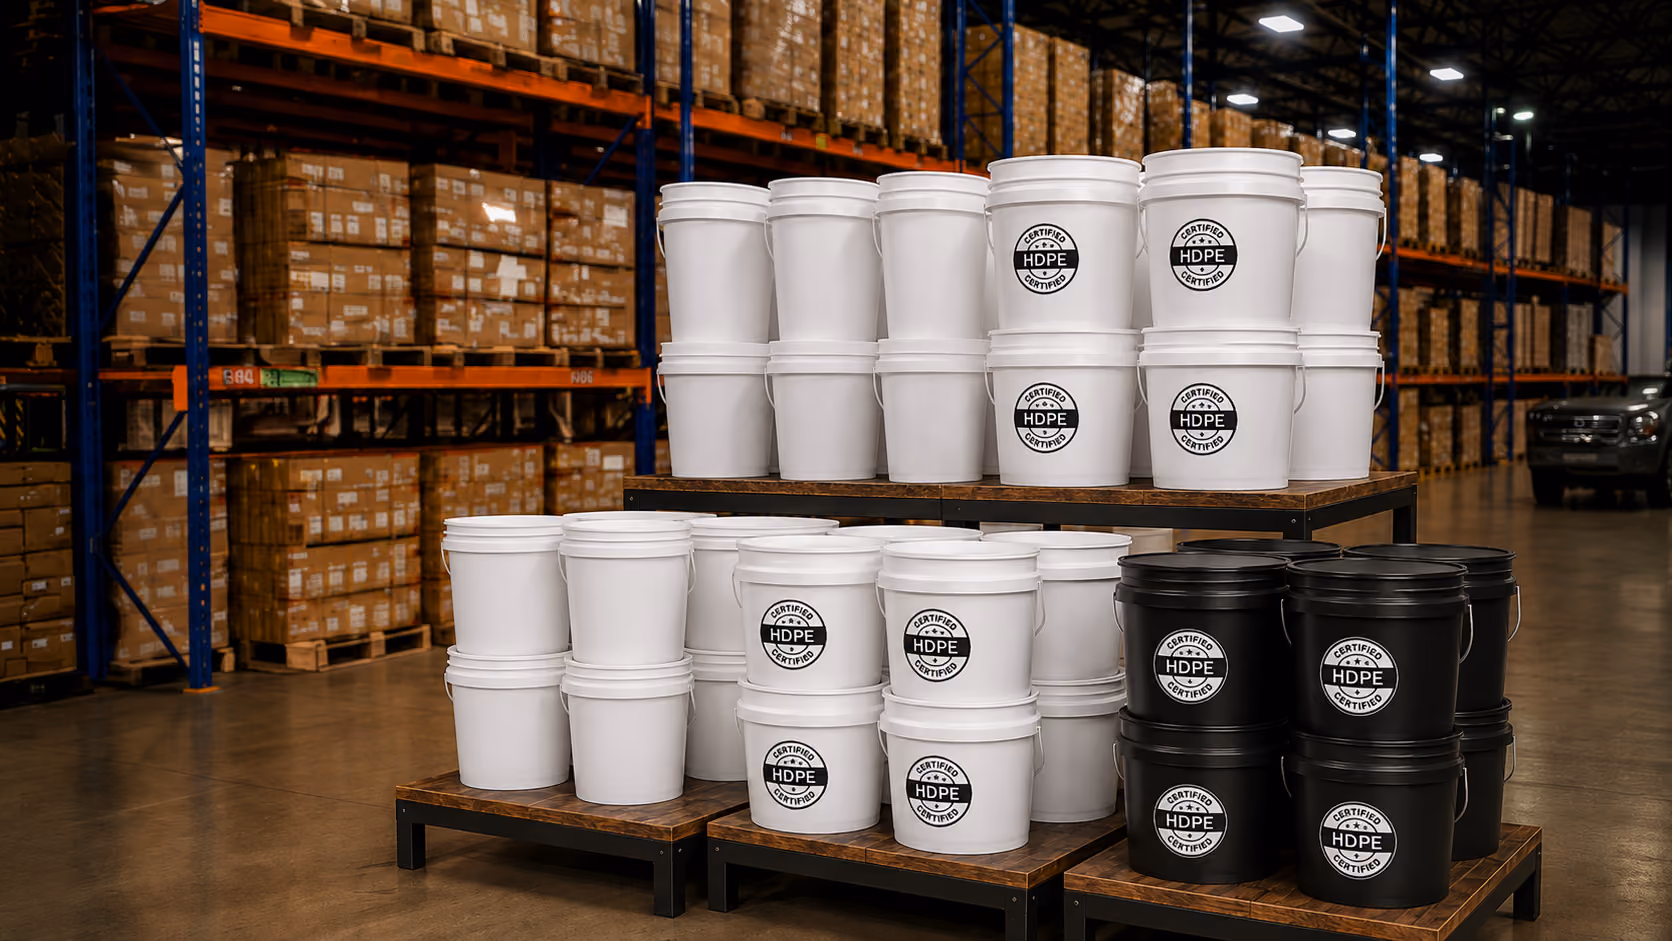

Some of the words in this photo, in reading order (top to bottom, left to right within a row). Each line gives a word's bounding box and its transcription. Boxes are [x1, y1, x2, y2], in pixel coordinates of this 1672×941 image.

[1024, 228, 1067, 244] CERTIFIED
[1180, 224, 1224, 239] CERTIFIED
[1024, 253, 1067, 267] HDPE
[1180, 249, 1225, 263] HDPE
[1024, 274, 1066, 290] CERTIFIED
[1180, 270, 1225, 286] CERTIFIED
[1024, 388, 1067, 403] CERTIFIED
[1180, 388, 1225, 403] CERTIFIED
[1024, 412, 1067, 426] HDPE
[1180, 413, 1225, 428] HDPE
[1024, 434, 1067, 448] CERTIFIED
[1180, 434, 1224, 451] CERTIFIED
[771, 604, 814, 620] CERTIFIED
[914, 614, 957, 631] CERTIFIED
[770, 628, 815, 643] HDPE
[1166, 635, 1213, 651] CERTIFIED
[913, 639, 959, 654] HDPE
[1333, 643, 1382, 660] CERTIFIED
[771, 649, 814, 665] CERTIFIED
[914, 659, 957, 678] CERTIFIED
[1166, 659, 1214, 675] HDPE
[1332, 669, 1383, 685] HDPE
[1167, 681, 1213, 698] CERTIFIED
[1333, 691, 1382, 710] CERTIFIED
[773, 745, 815, 761] CERTIFIED
[772, 769, 816, 784] HDPE
[916, 761, 959, 777] CERTIFIED
[773, 789, 815, 805] CERTIFIED
[915, 784, 960, 800] HDPE
[1167, 791, 1213, 807] CERTIFIED
[916, 805, 959, 822] CERTIFIED
[1332, 807, 1382, 825] CERTIFIED
[1166, 815, 1214, 830] HDPE
[1167, 835, 1213, 852] CERTIFIED
[1332, 832, 1382, 850] HDPE
[1333, 854, 1381, 873] CERTIFIED
